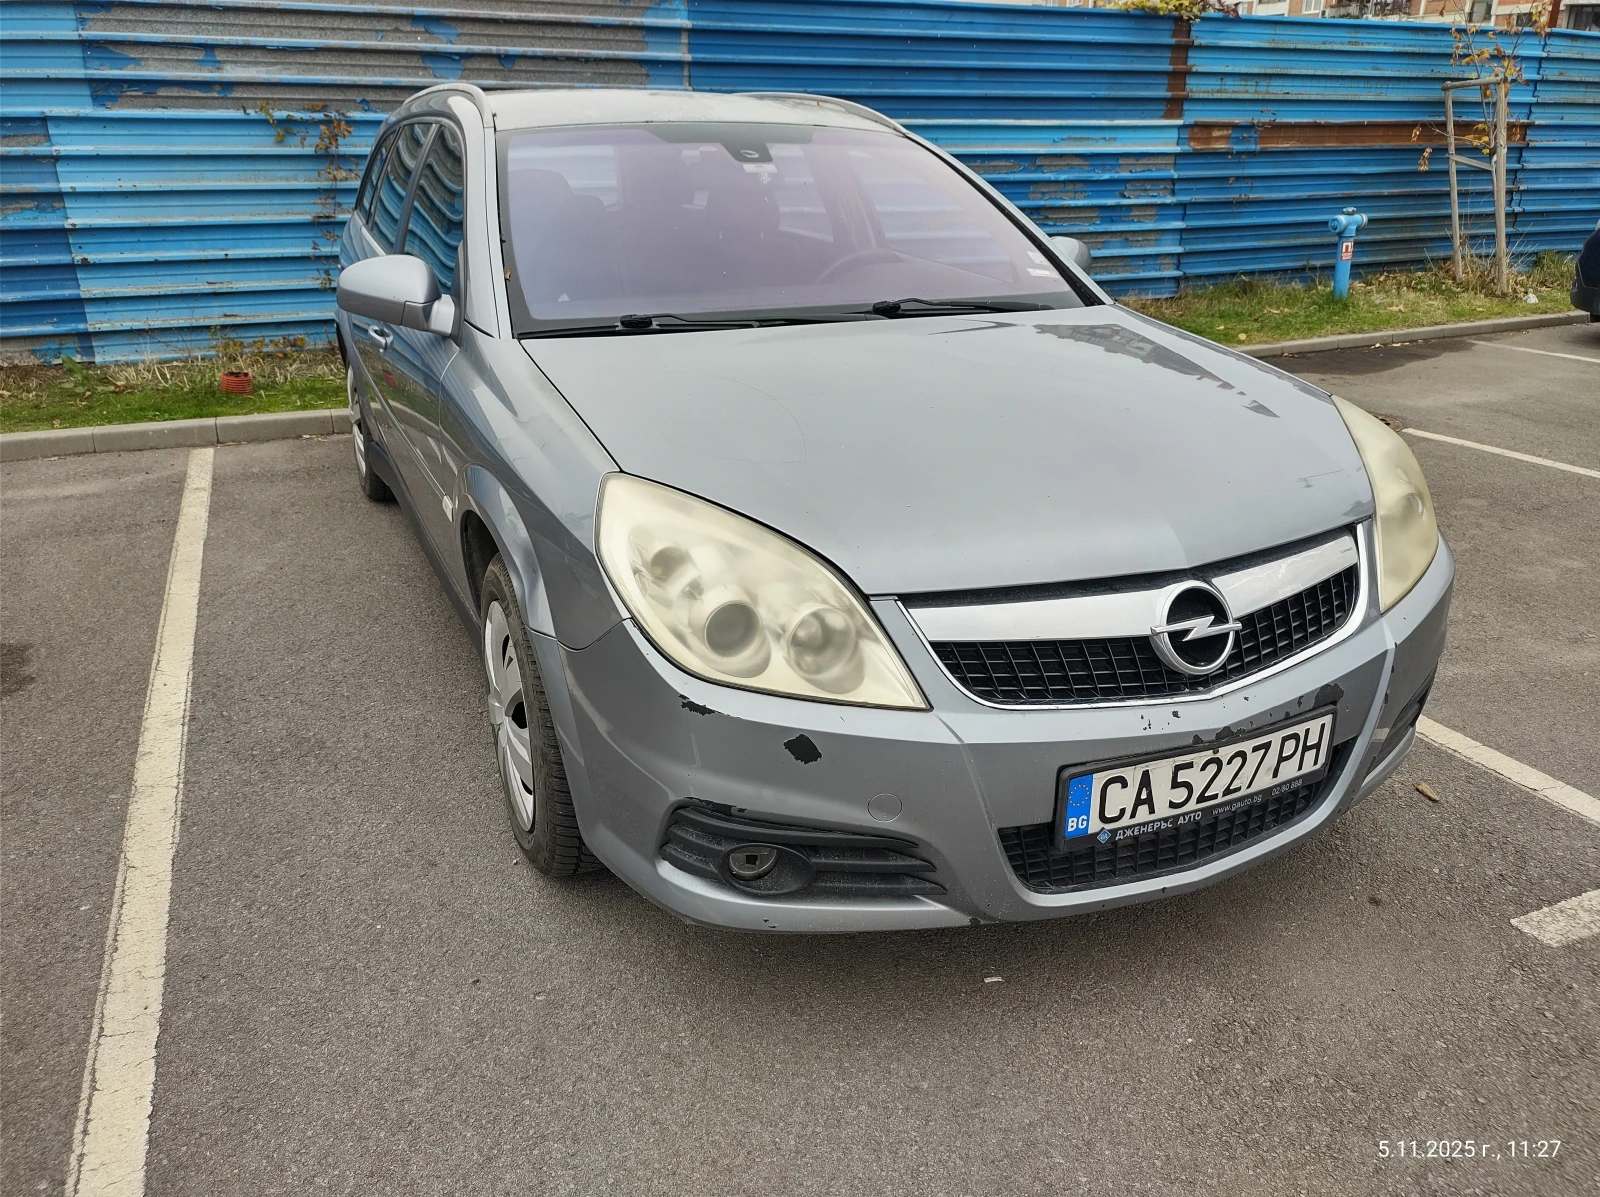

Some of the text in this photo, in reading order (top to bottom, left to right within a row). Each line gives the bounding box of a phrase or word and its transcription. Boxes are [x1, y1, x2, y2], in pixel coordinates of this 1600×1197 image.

[1168, 739, 1272, 809] 5227
[1212, 794, 1263, 815] www.gauto.bg
[1067, 815, 1088, 832] BG
[1115, 811, 1202, 841] ДЖЕНЕРЪС АУТО
